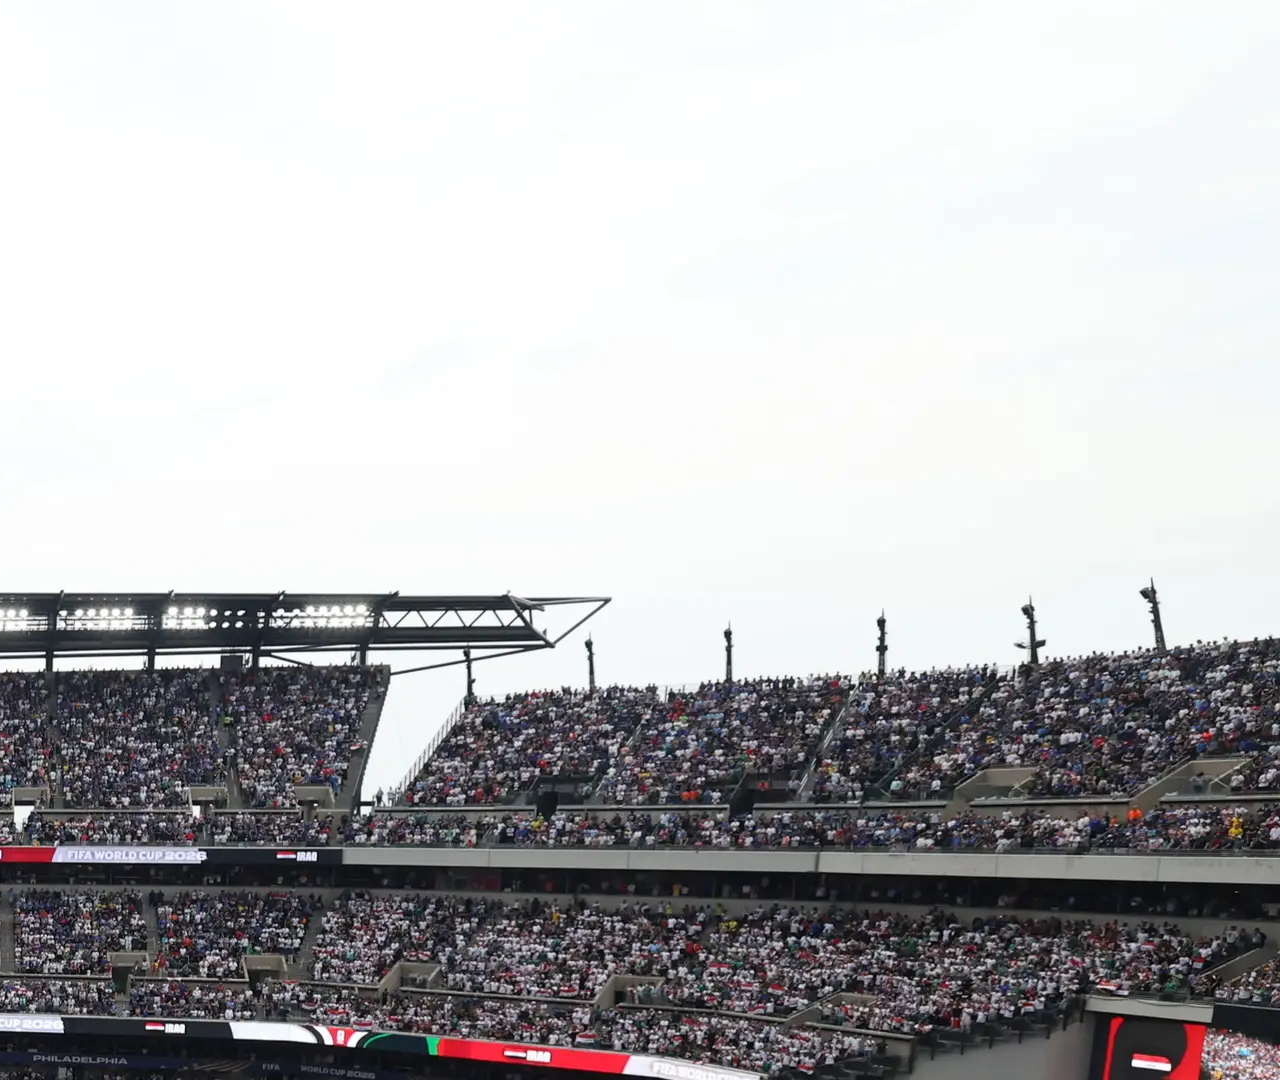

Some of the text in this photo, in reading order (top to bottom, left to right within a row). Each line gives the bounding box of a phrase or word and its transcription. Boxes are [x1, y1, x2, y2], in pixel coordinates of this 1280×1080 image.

[68, 851, 207, 860] FIFA WORLD CUP 2026
[296, 852, 317, 862] IRAQ
[22, 1020, 64, 1030] 2026
[165, 1024, 185, 1034] IRAQ
[33, 1055, 127, 1065] PHILADELPHIA
[300, 1065, 329, 1074] WORLD
[330, 1068, 345, 1076] CUP
